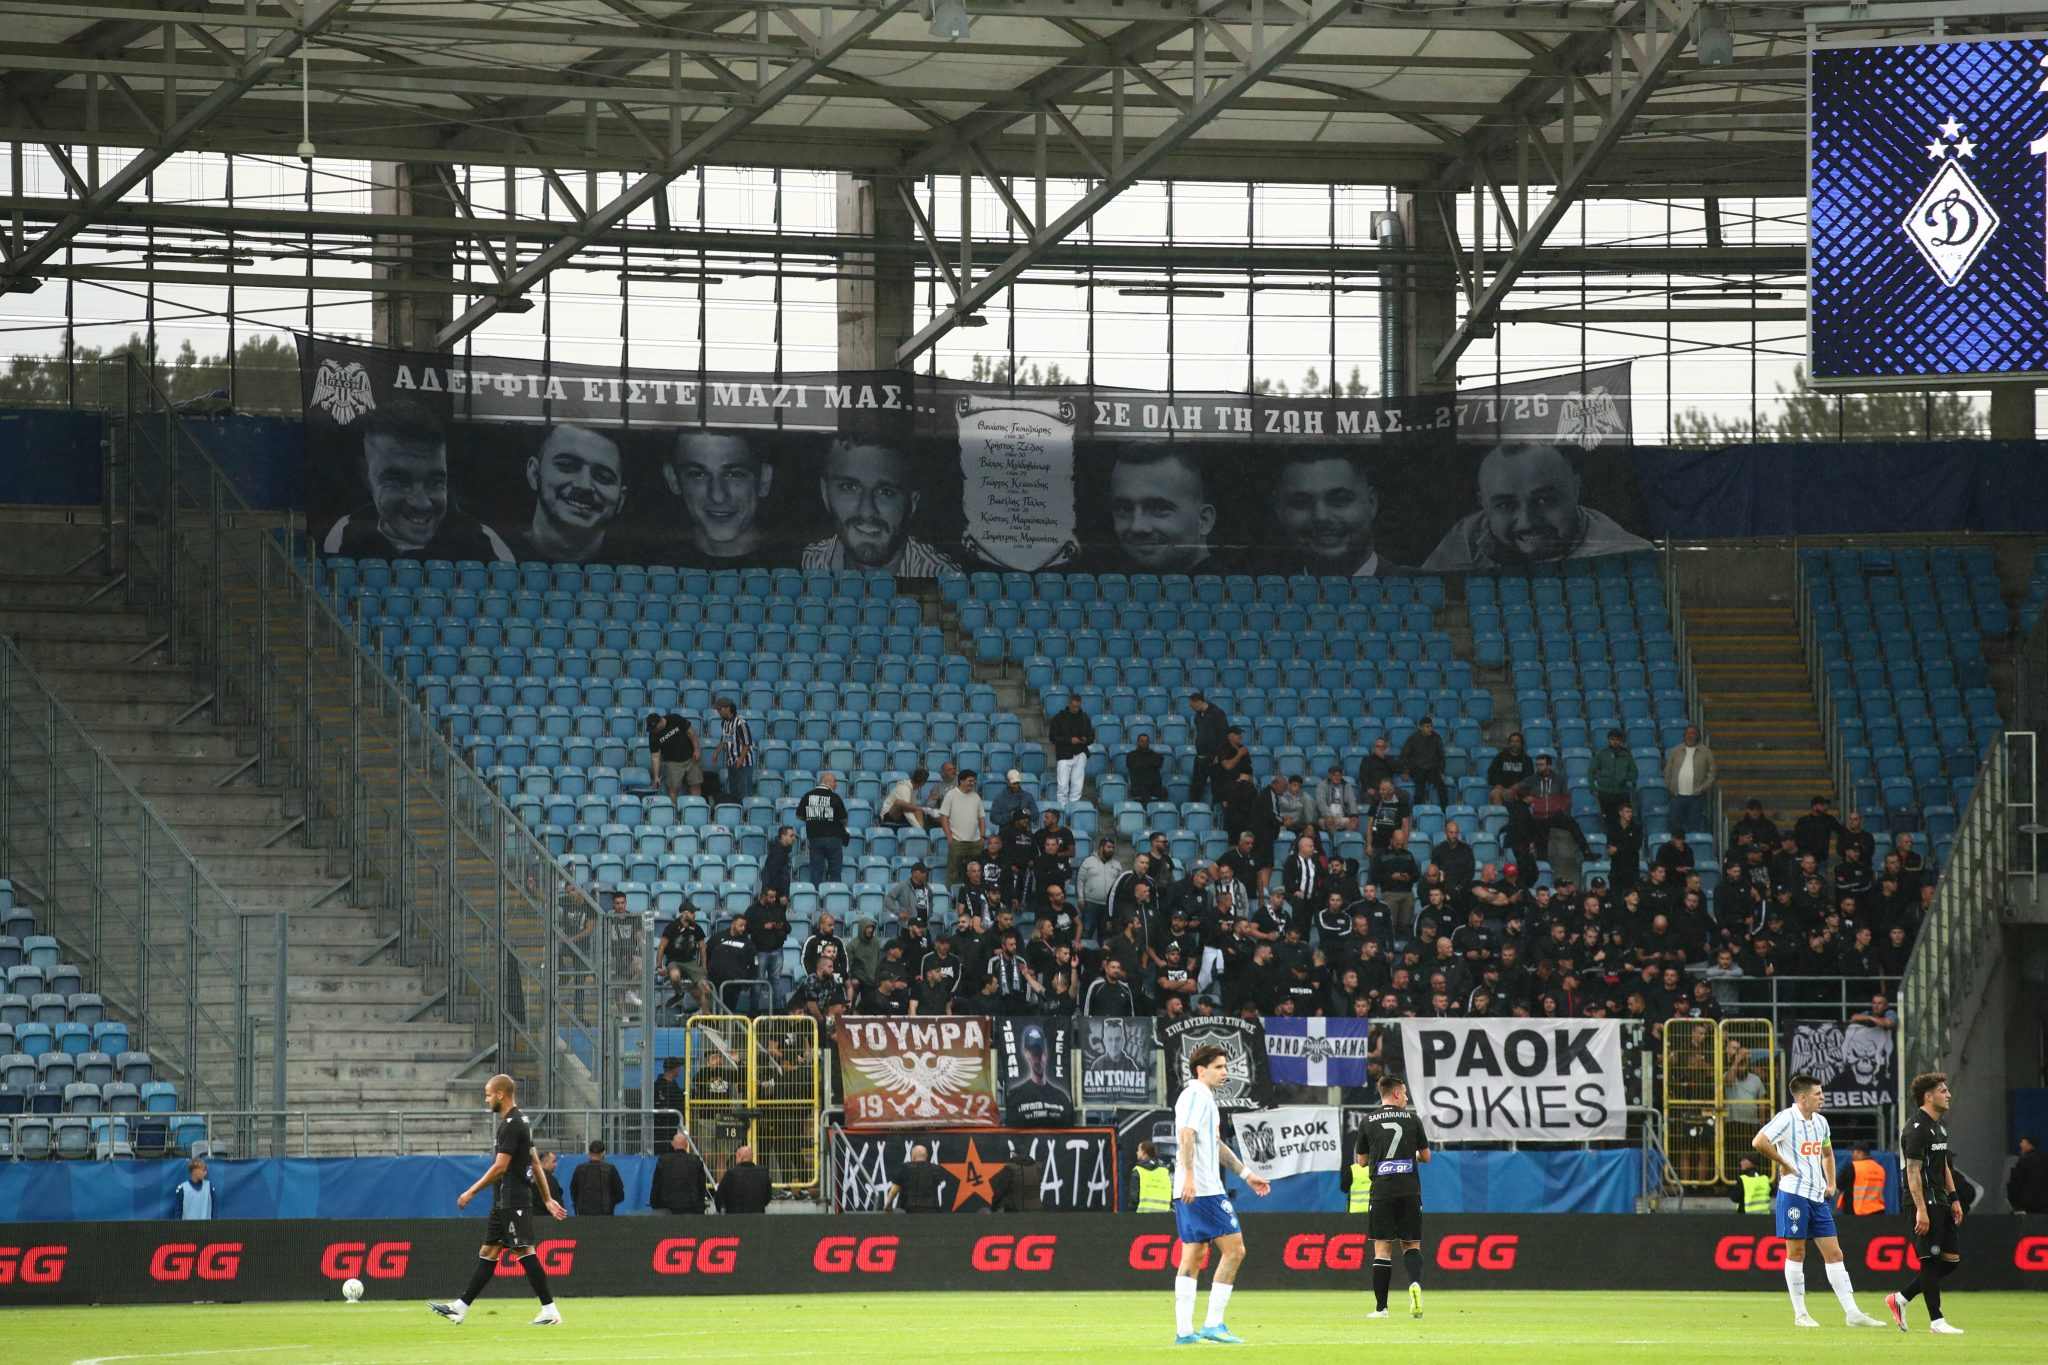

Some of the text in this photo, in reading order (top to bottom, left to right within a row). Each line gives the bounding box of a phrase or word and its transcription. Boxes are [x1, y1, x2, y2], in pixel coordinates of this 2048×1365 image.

[393, 365, 936, 413] ΑΔΕΡΦΙΑ ΕΙΣΤΕ ΜΑΖΙ ΜΑΣ...
[1094, 402, 1131, 426] ΣΕ
[1143, 404, 1202, 430] ΟΛΗ
[1215, 407, 1253, 432] ΤΗ
[1264, 409, 1324, 435] ΖΩΗ
[1418, 1028, 1604, 1078] PAOK
[1083, 1070, 1146, 1087] ΑΝΤΩΝΗ
[857, 1095, 884, 1118] 19
[960, 1094, 991, 1117] 72
[1369, 1111, 1411, 1122] SANTAMARIA
[1428, 1082, 1608, 1129] SIKIES
[1821, 1089, 1892, 1108] EBENA
[1279, 1140, 1337, 1157] EPTALOFOS
[1280, 1121, 1328, 1139] PAOK
[1381, 1122, 1403, 1159] 7
[1800, 1141, 1822, 1156] GG
[966, 1161, 984, 1187] 4
[508, 1221, 517, 1236] 4
[149, 1242, 244, 1281] GG
[320, 1241, 412, 1280] GG
[652, 1237, 741, 1275] GG
[813, 1235, 900, 1273] GG
[971, 1234, 1057, 1272] GG
[1283, 1233, 1368, 1271] GG
[1436, 1233, 1520, 1271] GG
